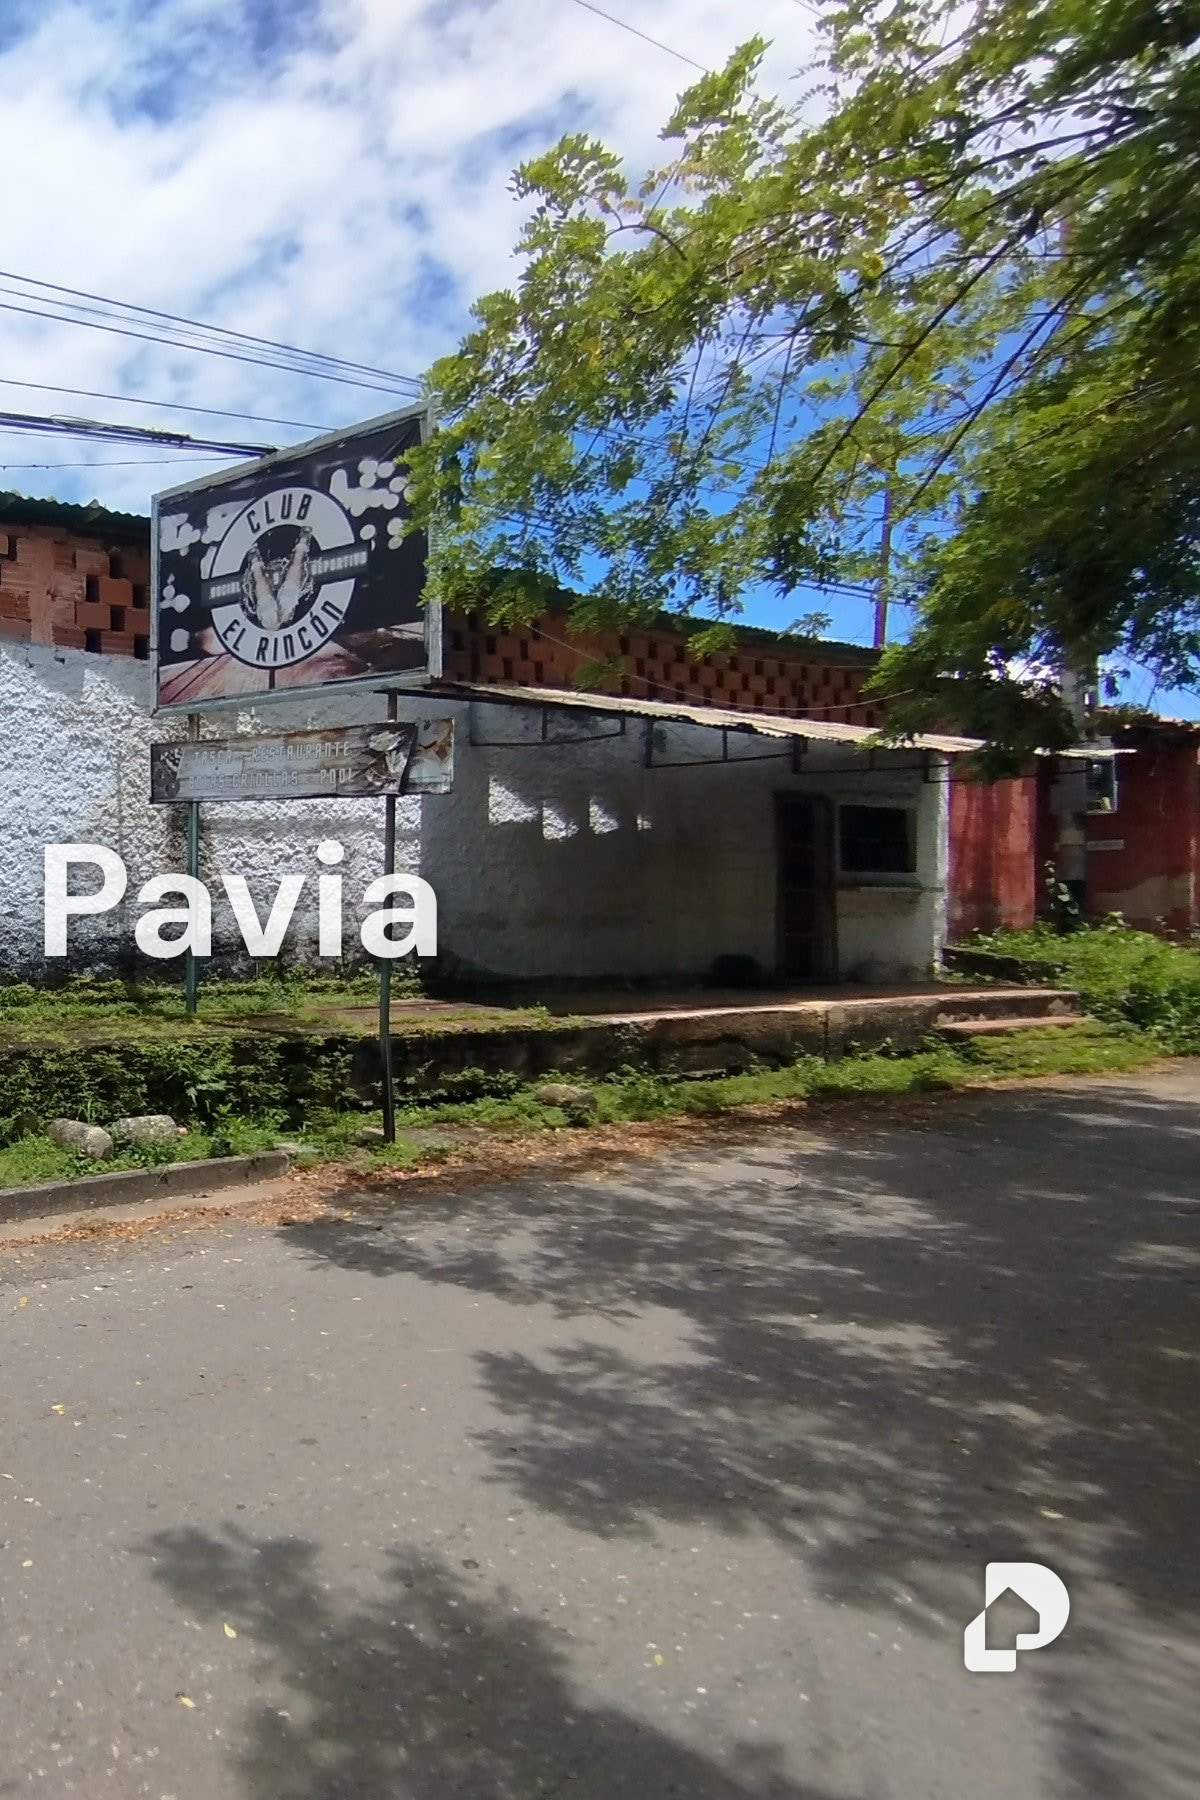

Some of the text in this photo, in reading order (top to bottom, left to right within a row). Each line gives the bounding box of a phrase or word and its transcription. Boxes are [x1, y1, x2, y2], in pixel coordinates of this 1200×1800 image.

[246, 493, 313, 534] CLUB
[210, 551, 368, 600] SOCIAL DEPORTIVO
[221, 600, 344, 663] EL RINCÓN
[194, 740, 351, 766] TASCA RESTAURANTE
[232, 771, 298, 788] CRIOLLAS
[320, 767, 354, 785] POOL
